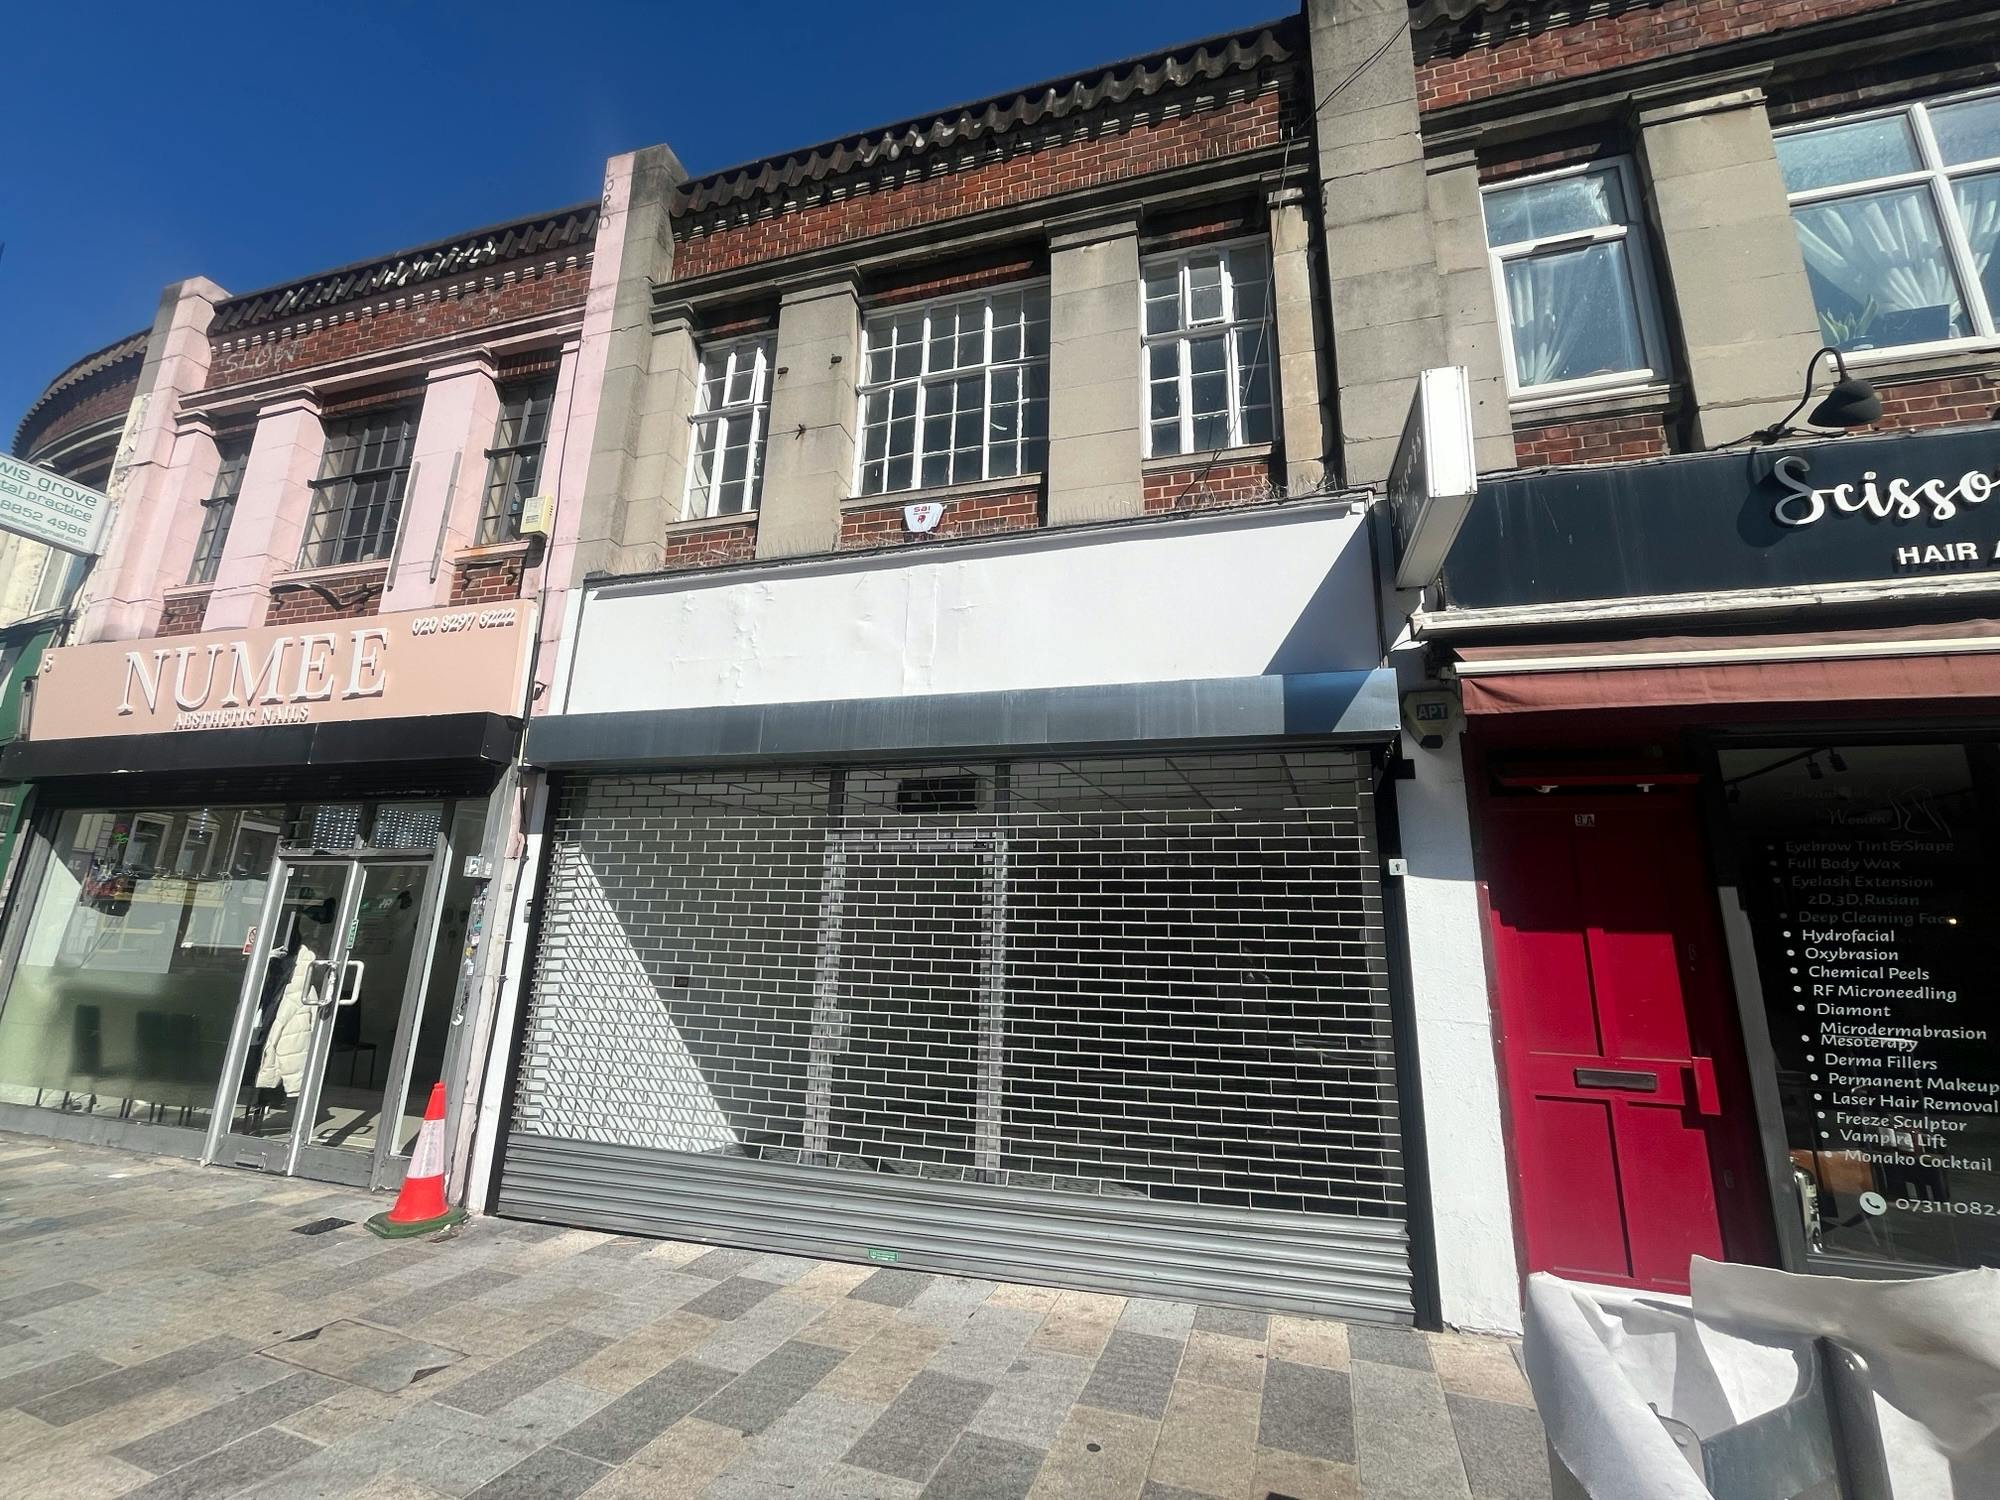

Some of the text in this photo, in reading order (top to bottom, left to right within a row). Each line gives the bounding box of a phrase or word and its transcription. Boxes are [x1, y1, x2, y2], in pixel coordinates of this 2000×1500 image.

[38, 477, 97, 507] grove
[26, 491, 92, 520] practice
[0, 499, 43, 521] 8852
[47, 517, 88, 538] 4986
[1898, 542, 1979, 566] HAIR
[411, 607, 515, 636] 020 8297 6222
[44, 653, 54, 673] 5
[117, 627, 389, 714] NUMEE
[173, 703, 309, 730] AESTHETIC NAILS
[1418, 703, 1448, 720] APT
[1786, 840, 1852, 854] Eyebrow
[1787, 857, 1902, 872] Full Body Wax
[1792, 875, 1934, 890] Eyelash Extension
[1798, 911, 1839, 926] Deep
[1842, 911, 1914, 927] Cleaning
[1802, 929, 1895, 944] Hydrofacial
[1805, 947, 1899, 962] Oxybrasion
[1808, 965, 1930, 980] Chemical Peels
[1813, 985, 1957, 1003] RF Microneedling
[1817, 1003, 1891, 1017] Diamont
[1820, 1022, 1987, 1040] Microdermabrasion
[1820, 1034, 1919, 1053] Mesoterapy
[1825, 1053, 1938, 1071] Derma Fillers
[1828, 1072, 1999, 1096] Permanent Makeup
[1832, 1092, 1999, 1114] Laser Hair Removal
[1836, 1111, 1968, 1133] Freeze Sculptor
[1840, 1129, 1948, 1149] Vampire Lift
[1844, 1149, 1992, 1172] Monako Cocktail
[1895, 1198, 2000, 1217] 07311082
